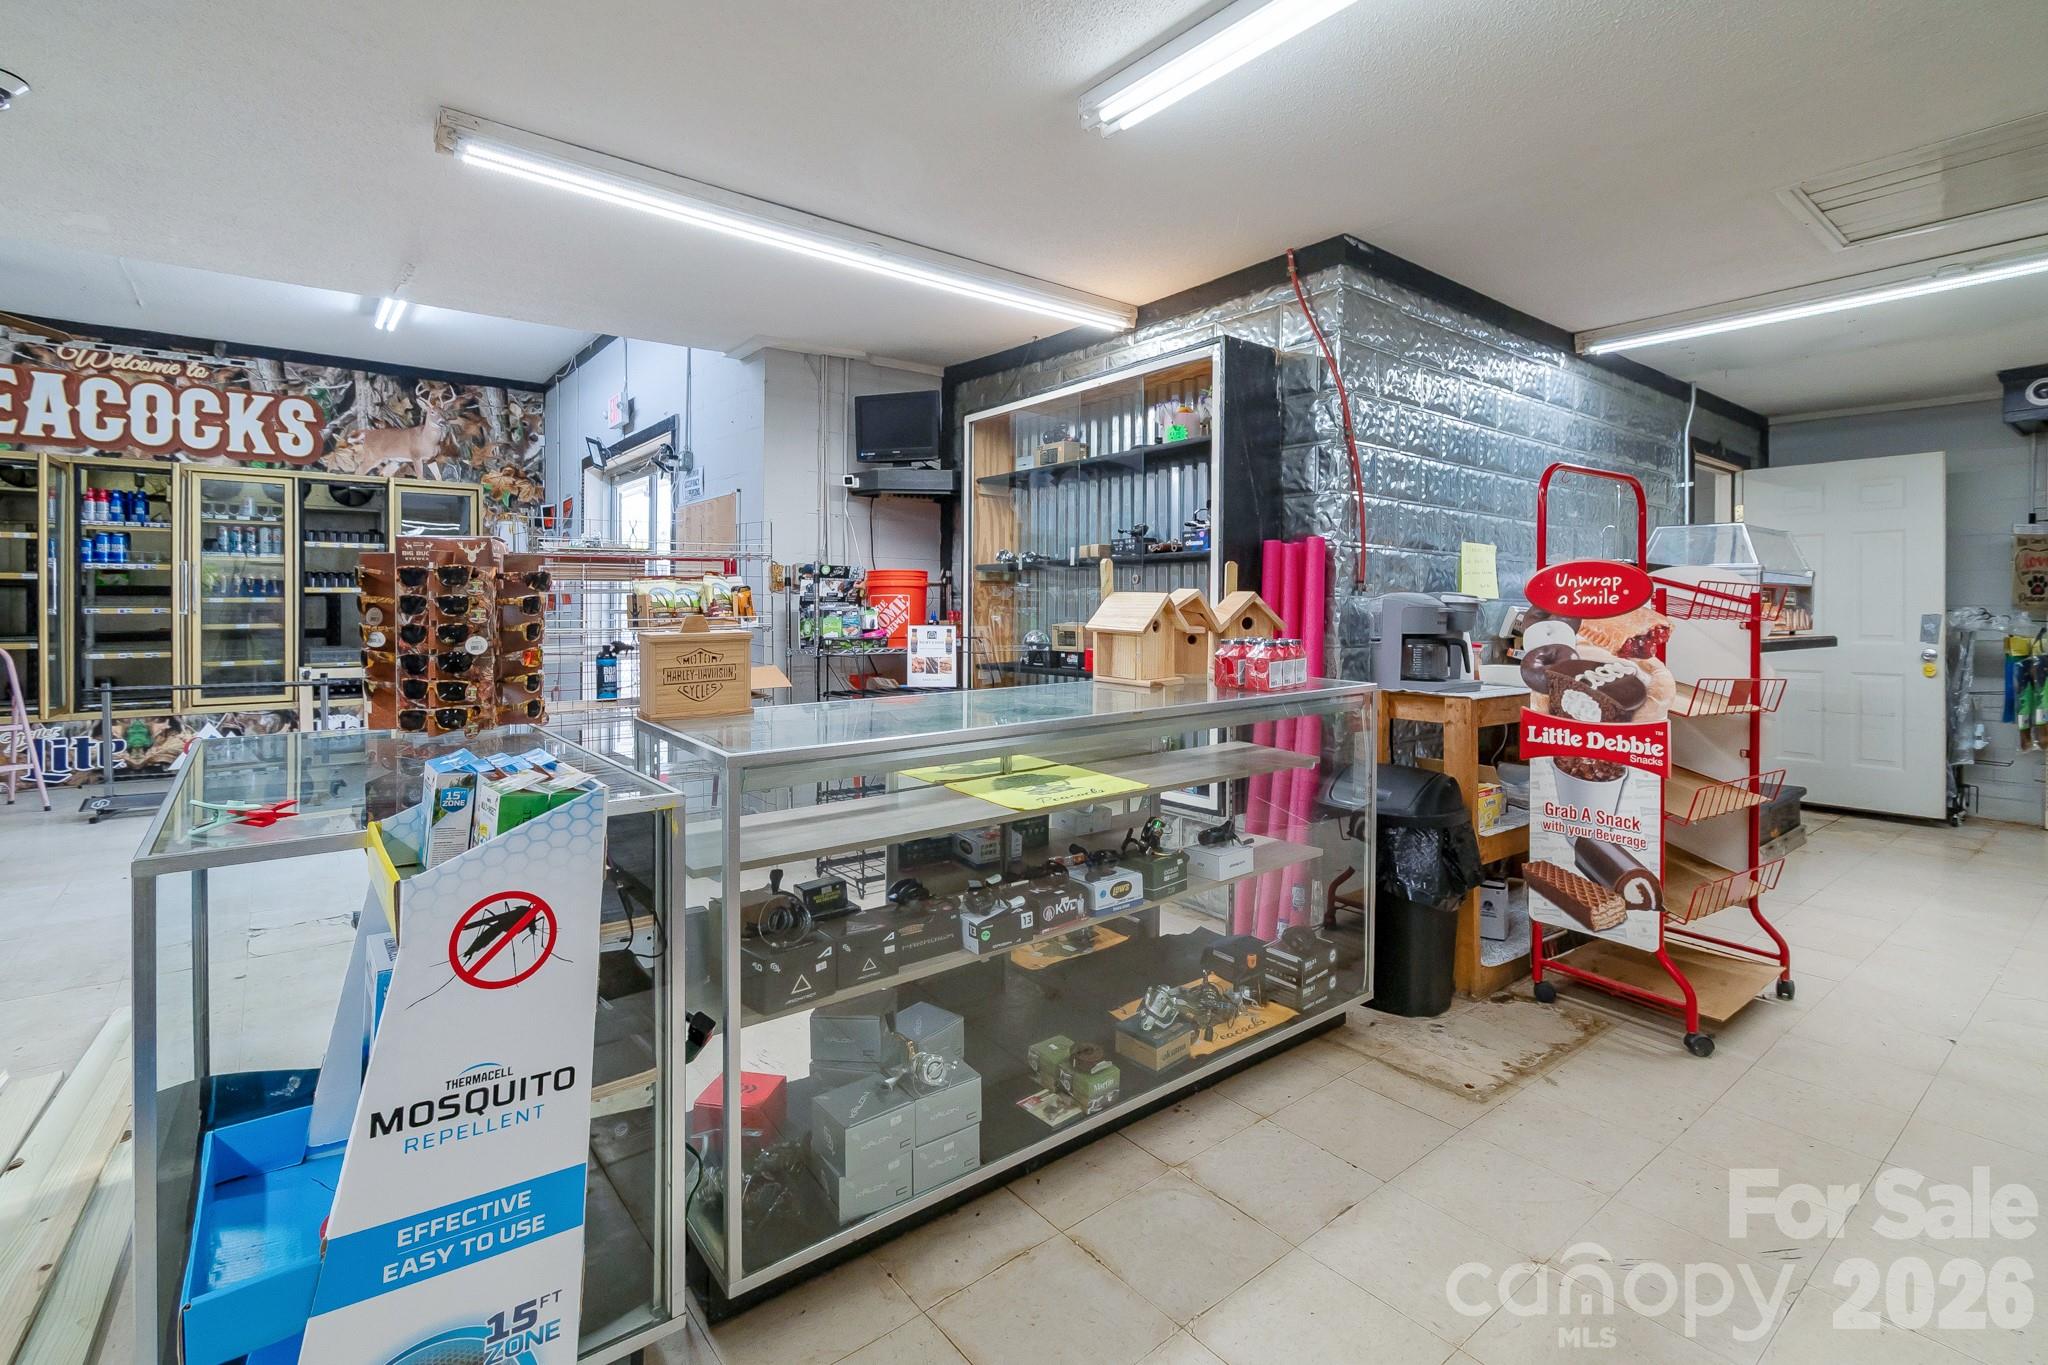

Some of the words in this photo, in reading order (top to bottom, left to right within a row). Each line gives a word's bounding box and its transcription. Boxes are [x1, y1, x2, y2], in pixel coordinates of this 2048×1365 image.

[57, 346, 181, 377] Welcome
[186, 360, 209, 379] to
[1555, 573, 1622, 591] Unwrap
[1557, 595, 1568, 605] a
[1572, 588, 1620, 605] Smile
[682, 652, 719, 665] MOTOR
[666, 667, 734, 682] HARLEY-DAVIDSON
[683, 682, 718, 699] CYCLES
[1526, 725, 1583, 748] Little
[1586, 731, 1665, 757] Debbie
[1629, 754, 1664, 767] Snacks
[442, 798, 466, 808] ZONE
[444, 790, 460, 801] 15
[1544, 801, 1578, 820] Grab
[1581, 807, 1592, 822] A
[1596, 809, 1641, 832] Snack
[1542, 820, 1565, 833] with
[1568, 825, 1593, 837] your
[1596, 828, 1647, 849] Beverage
[1022, 915, 1032, 926] 13
[446, 1066, 514, 1091] THERMACELL
[369, 1066, 576, 1139] MOSQUITO
[404, 1104, 545, 1154] REPELLENT
[397, 1189, 532, 1248] EFFECTIVE
[383, 1244, 454, 1284] EASY
[460, 1231, 494, 1257] TO
[499, 1213, 546, 1244] USE
[486, 1298, 538, 1345] 15
[539, 1288, 563, 1309] FT
[484, 1318, 561, 1365] ZONE
